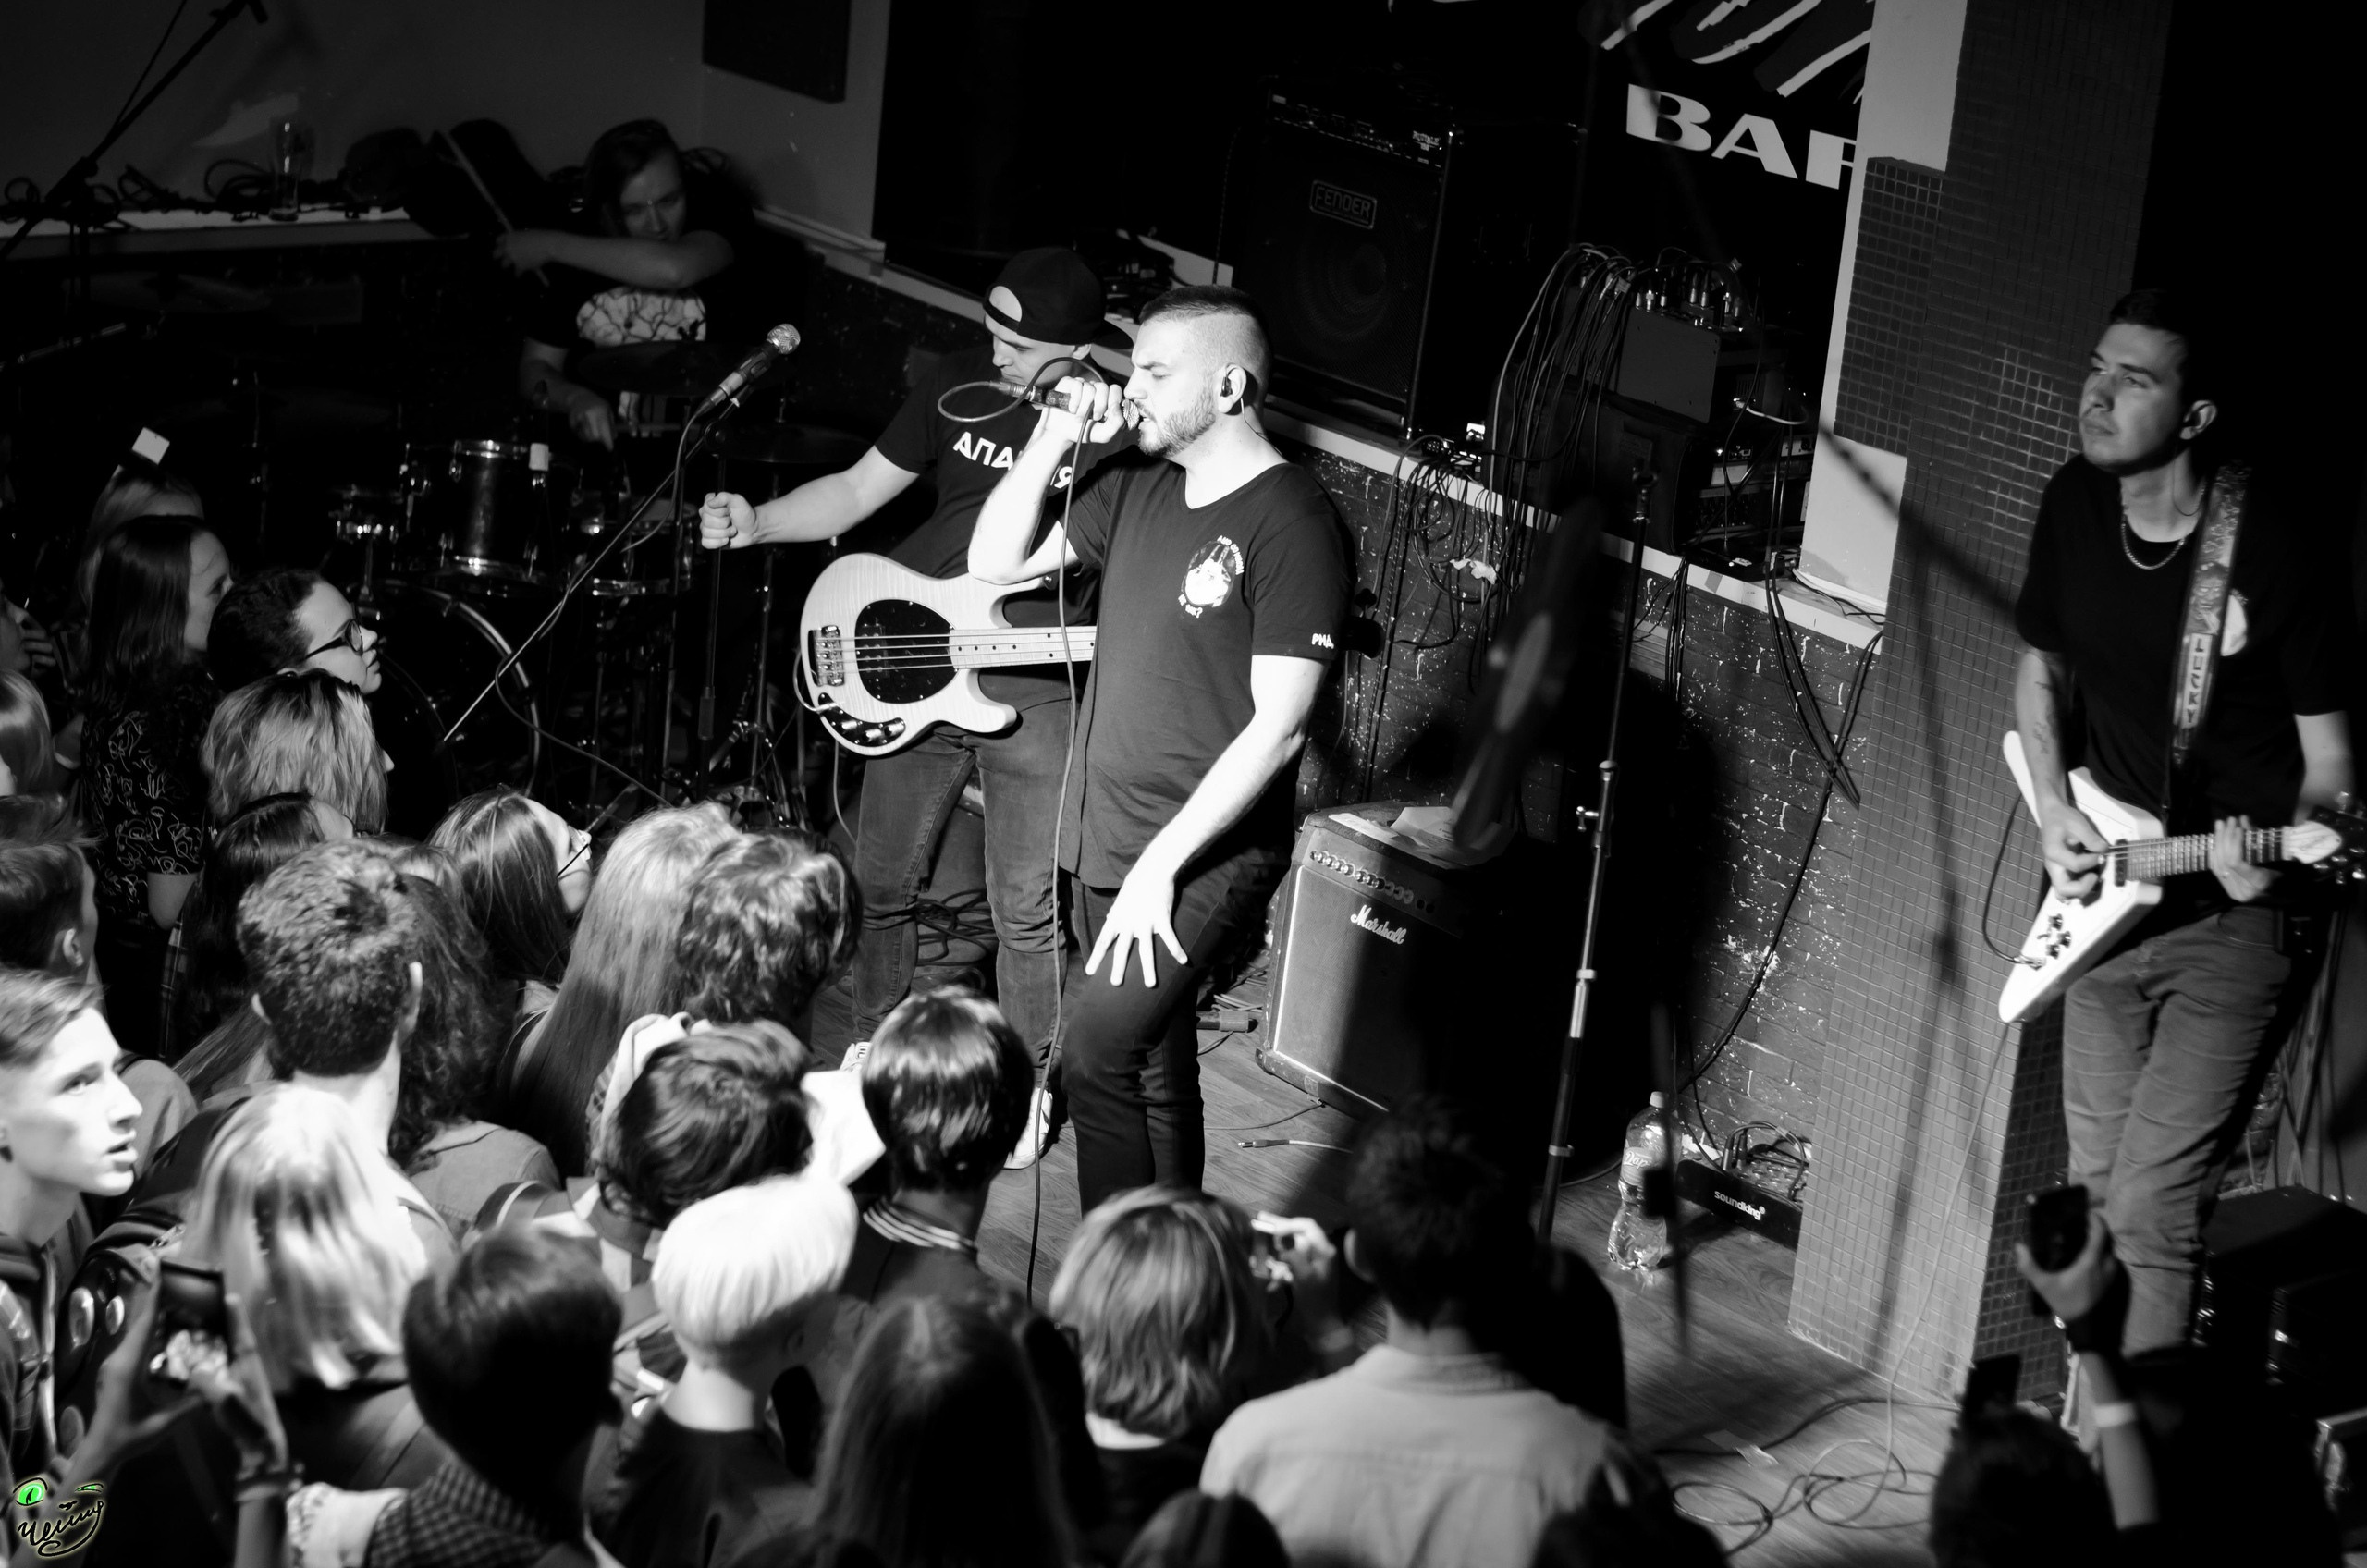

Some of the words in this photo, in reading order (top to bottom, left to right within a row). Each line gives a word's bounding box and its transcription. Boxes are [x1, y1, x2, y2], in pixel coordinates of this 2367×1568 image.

[952, 431, 1073, 489] АПАЯ
[1350, 904, 1407, 945] Marshall
[1713, 1190, 1762, 1221] soundking
